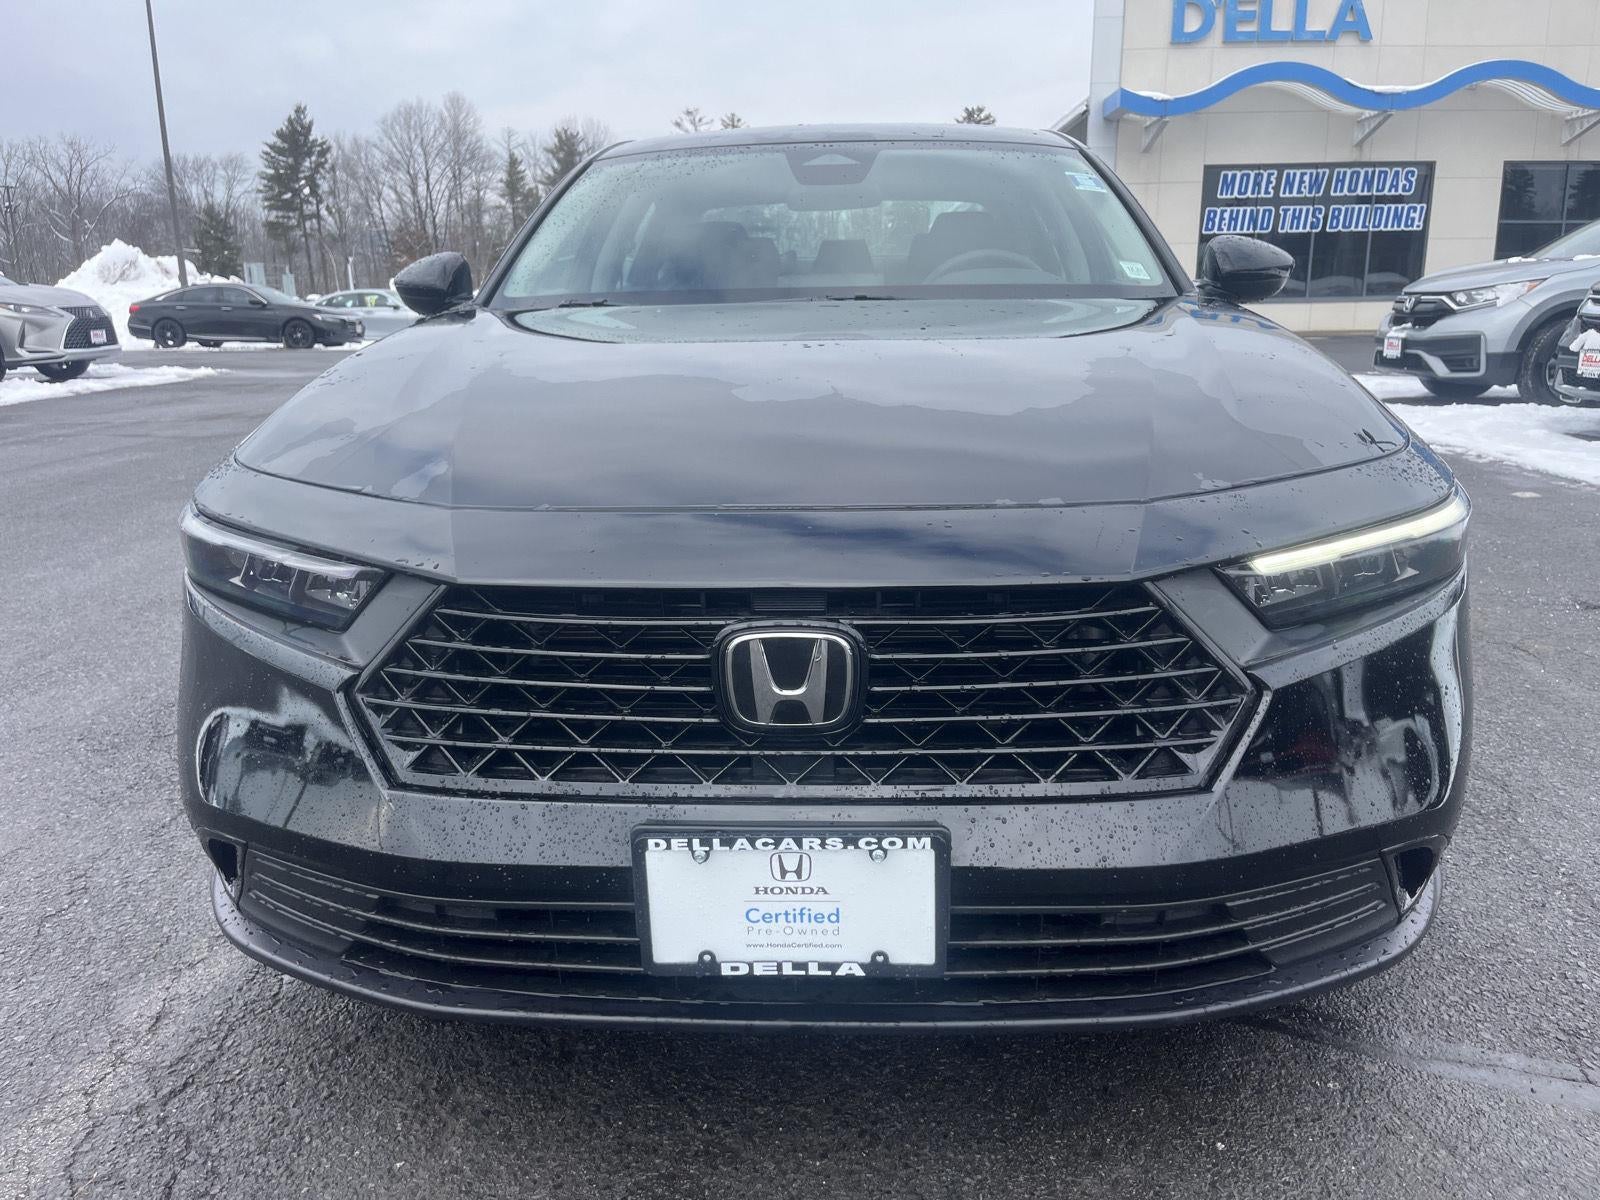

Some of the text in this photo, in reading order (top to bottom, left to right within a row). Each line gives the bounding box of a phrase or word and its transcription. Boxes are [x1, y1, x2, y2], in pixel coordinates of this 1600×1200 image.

[1217, 167, 1417, 198] MORE NEW HONDAS
[1202, 204, 1428, 234] BEHIND THIS BUILDING!
[647, 837, 931, 851] DELLACARS.COM
[753, 886, 829, 895] HONDA
[745, 907, 840, 924] Certified
[747, 926, 840, 936] Pre-Owned
[720, 961, 866, 976] DELLA
